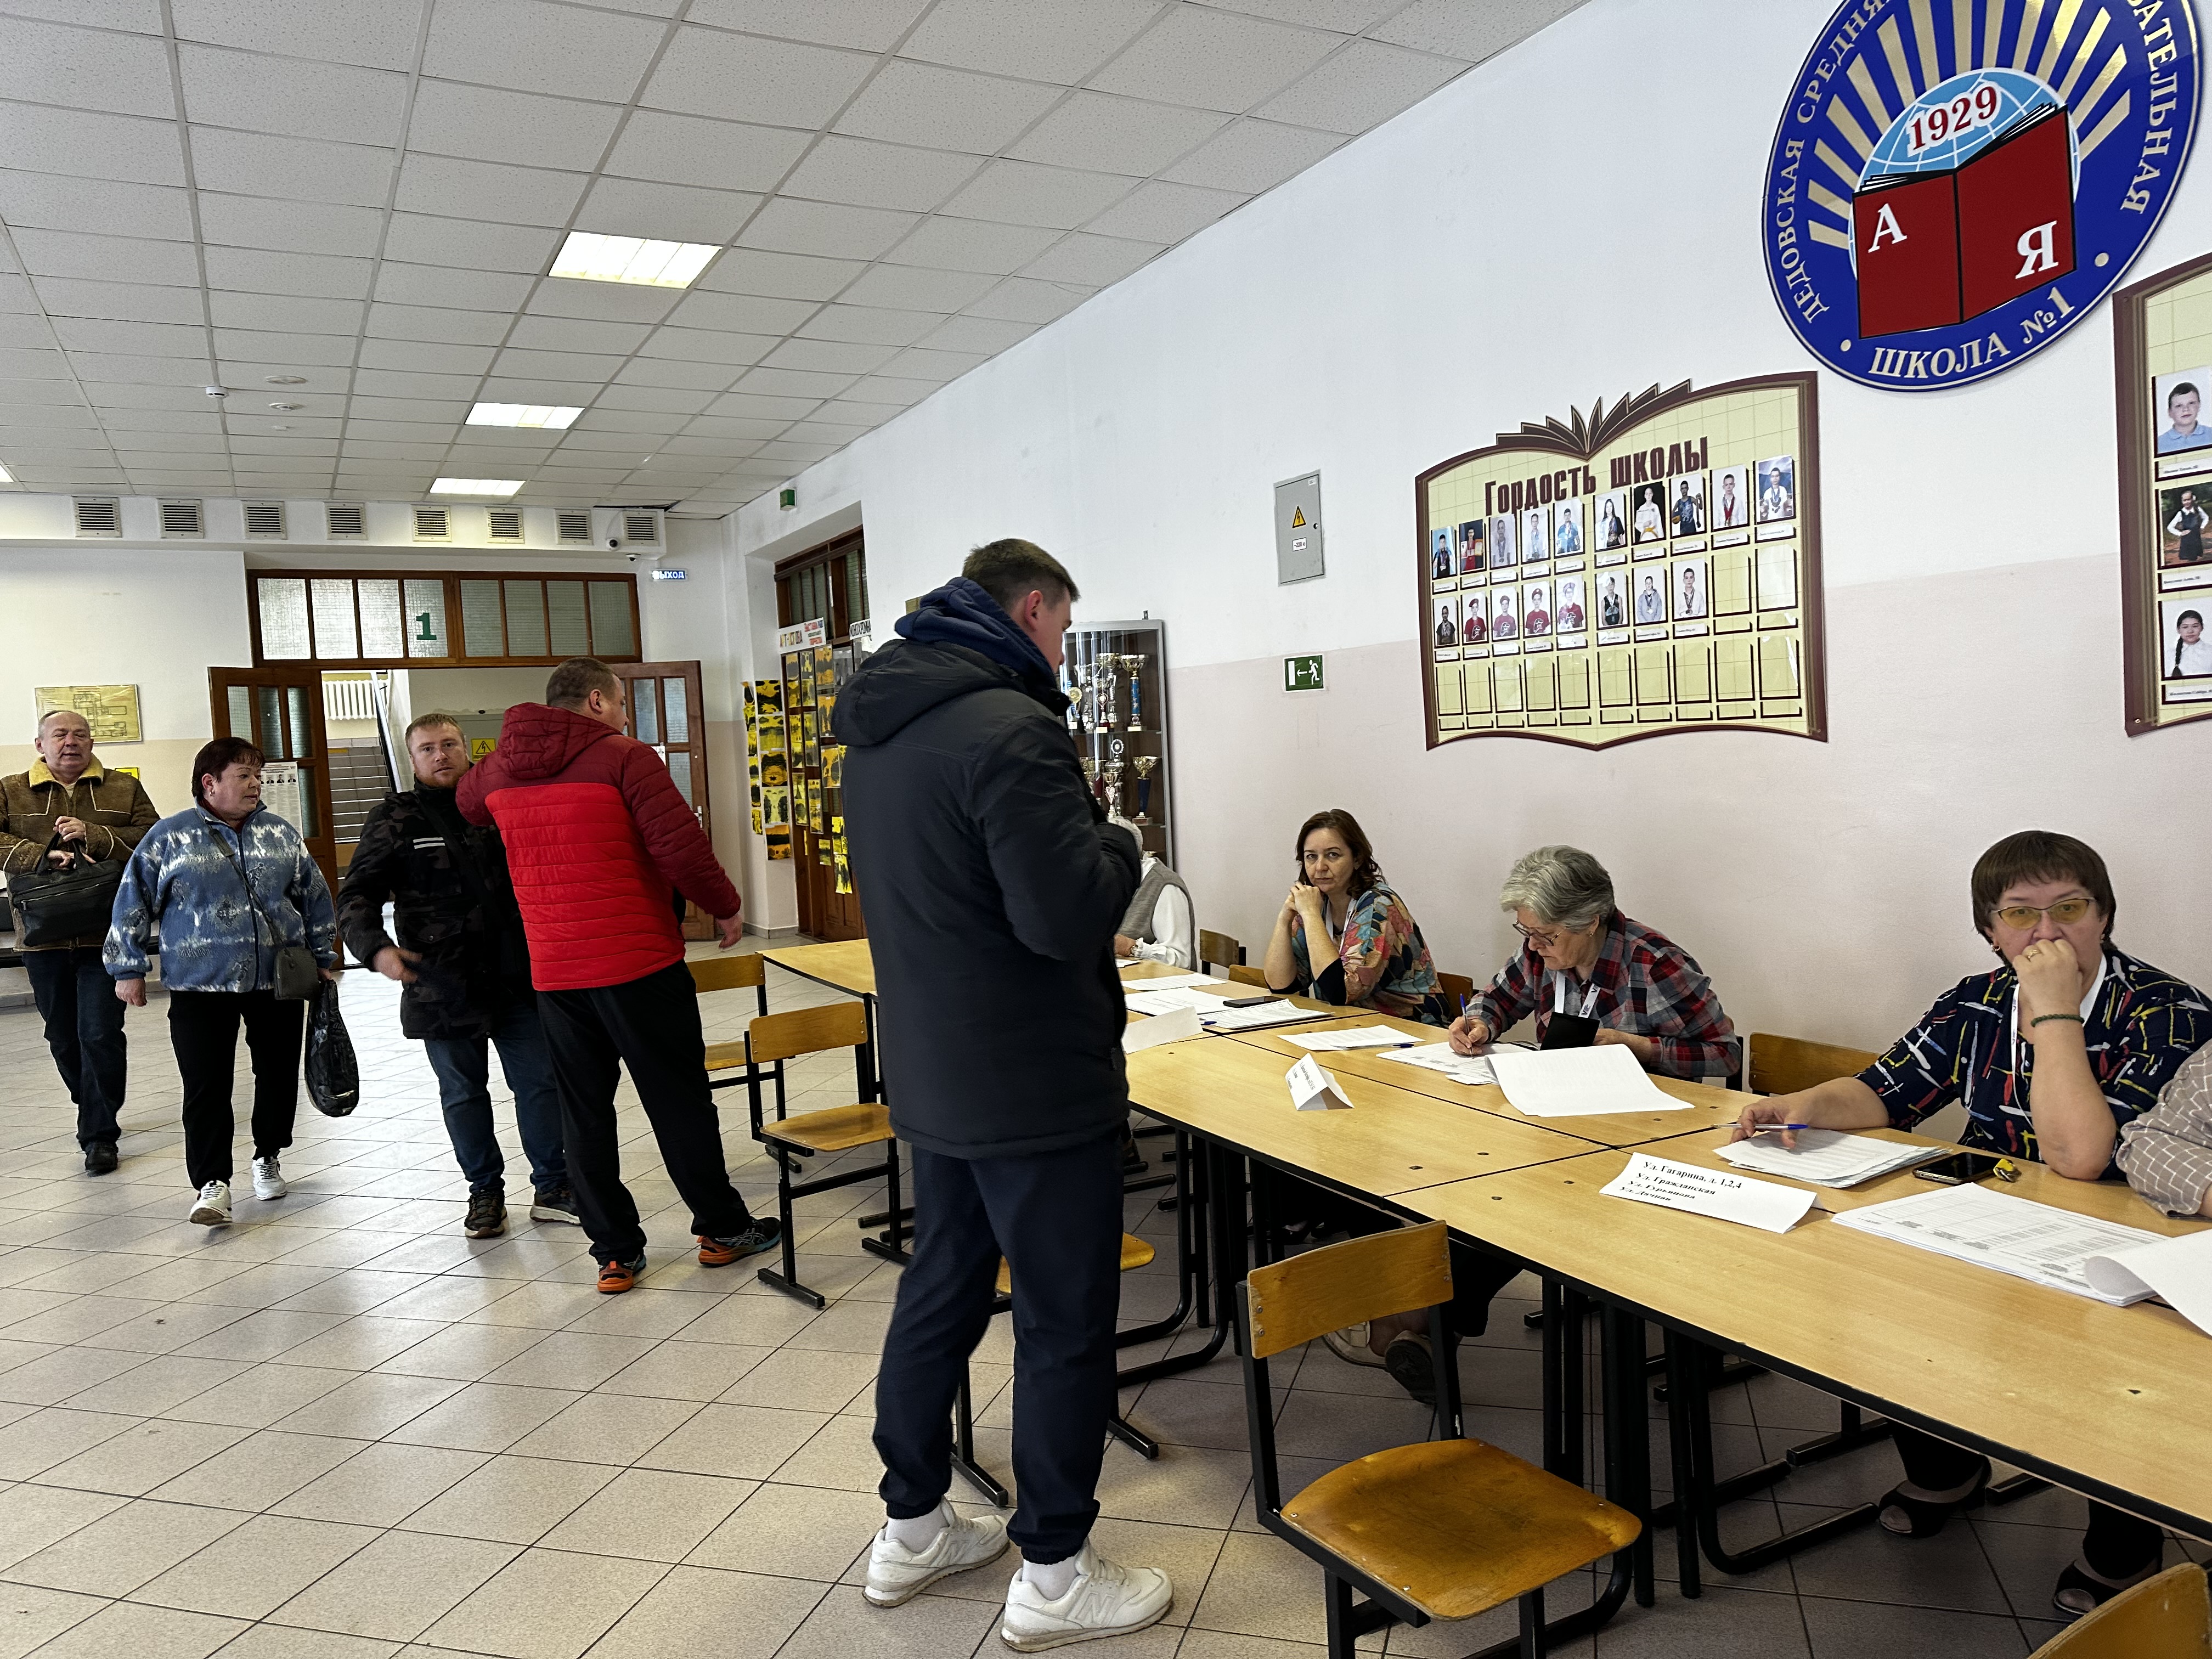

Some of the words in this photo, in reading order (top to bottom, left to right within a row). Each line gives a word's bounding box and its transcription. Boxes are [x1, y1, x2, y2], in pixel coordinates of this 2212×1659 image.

[1797, 0, 1889, 123] СРЕДНЯ
[1912, 86, 1997, 151] 1929
[1776, 139, 1830, 324] ДЕДОВСКАЯ
[1868, 204, 1907, 252] А
[2015, 221, 2058, 280] Я
[1868, 332, 2011, 379] ШКОЛА
[2022, 286, 2075, 345] №1
[652, 571, 685, 579] ЫХОД
[416, 612, 437, 640] 1
[1643, 1161, 1657, 1171] Ул.
[1661, 1165, 1706, 1182] Гагарина,
[1653, 1177, 1716, 1195] Гражданская
